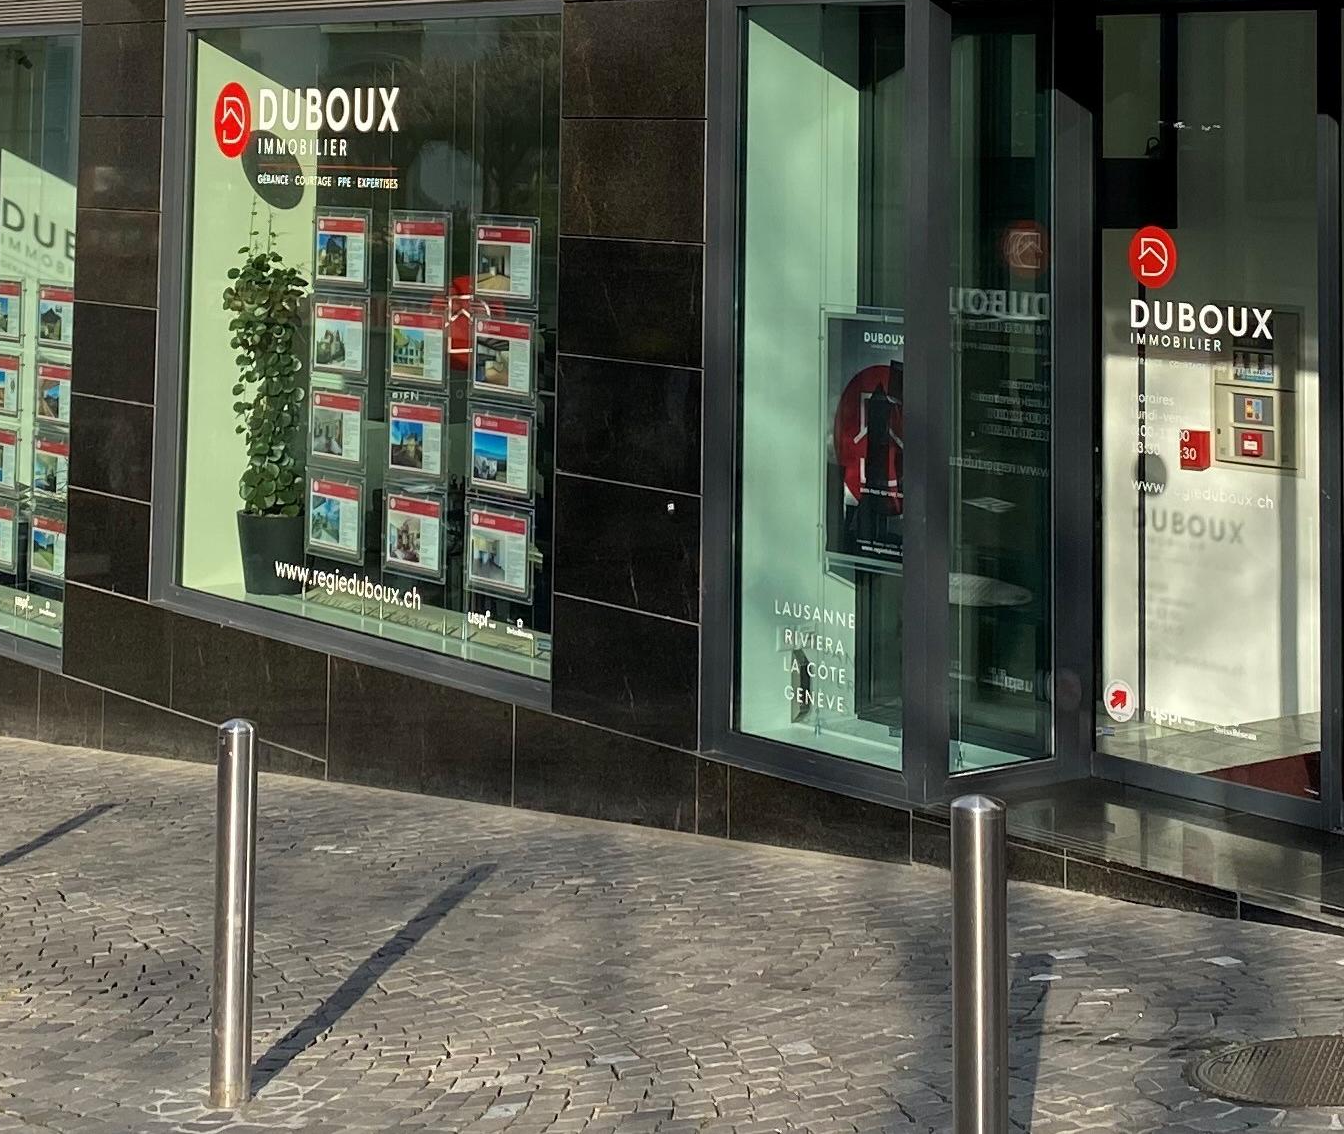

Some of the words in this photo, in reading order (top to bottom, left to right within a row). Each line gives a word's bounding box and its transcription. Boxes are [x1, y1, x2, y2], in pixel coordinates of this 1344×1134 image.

[258, 86, 400, 133] DUBOUX
[257, 137, 348, 157] IMMOBILIER
[294, 174, 332, 187] COURTAGE
[337, 176, 352, 187] PPE
[357, 176, 399, 189] EXPERTISES
[1130, 298, 1274, 340] DUBOUX
[863, 331, 905, 345] DUBOUX
[1130, 333, 1222, 352] IMMOBILIER
[274, 559, 422, 611] www.regieduboux.ch
[774, 599, 856, 630] LAUSANNE
[784, 629, 845, 656] RIVIERA
[783, 656, 801, 674] LA
[806, 660, 846, 685] CÔTE
[783, 685, 845, 713] GENÈVE
